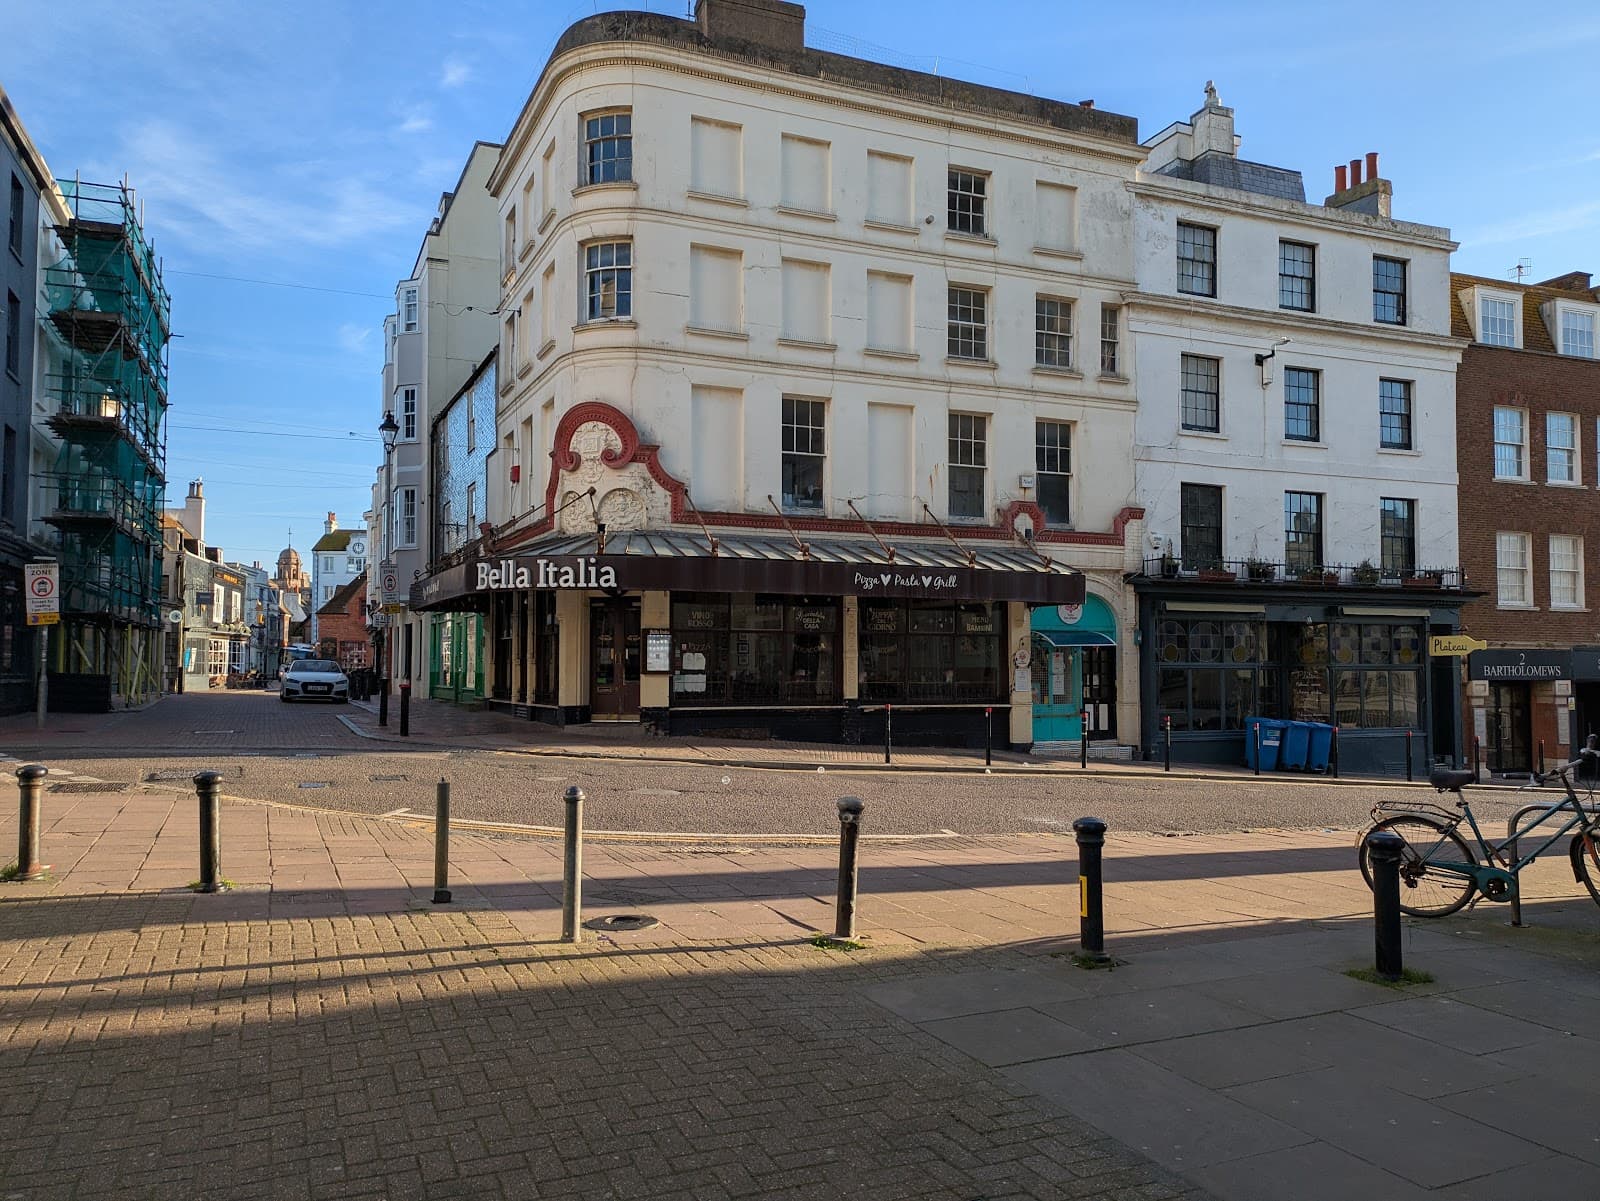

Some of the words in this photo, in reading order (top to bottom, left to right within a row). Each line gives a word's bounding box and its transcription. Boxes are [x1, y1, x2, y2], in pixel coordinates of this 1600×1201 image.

[475, 559, 531, 590] Bella
[536, 557, 617, 588] Italia
[854, 572, 880, 590] Pizza
[894, 573, 920, 586] Pasta
[933, 574, 958, 590] Grill
[966, 623, 993, 633] BAMBINI
[1434, 638, 1468, 653] Plateau
[1519, 652, 1526, 665] 2
[1483, 665, 1561, 677] BARTHOLOMEWS
